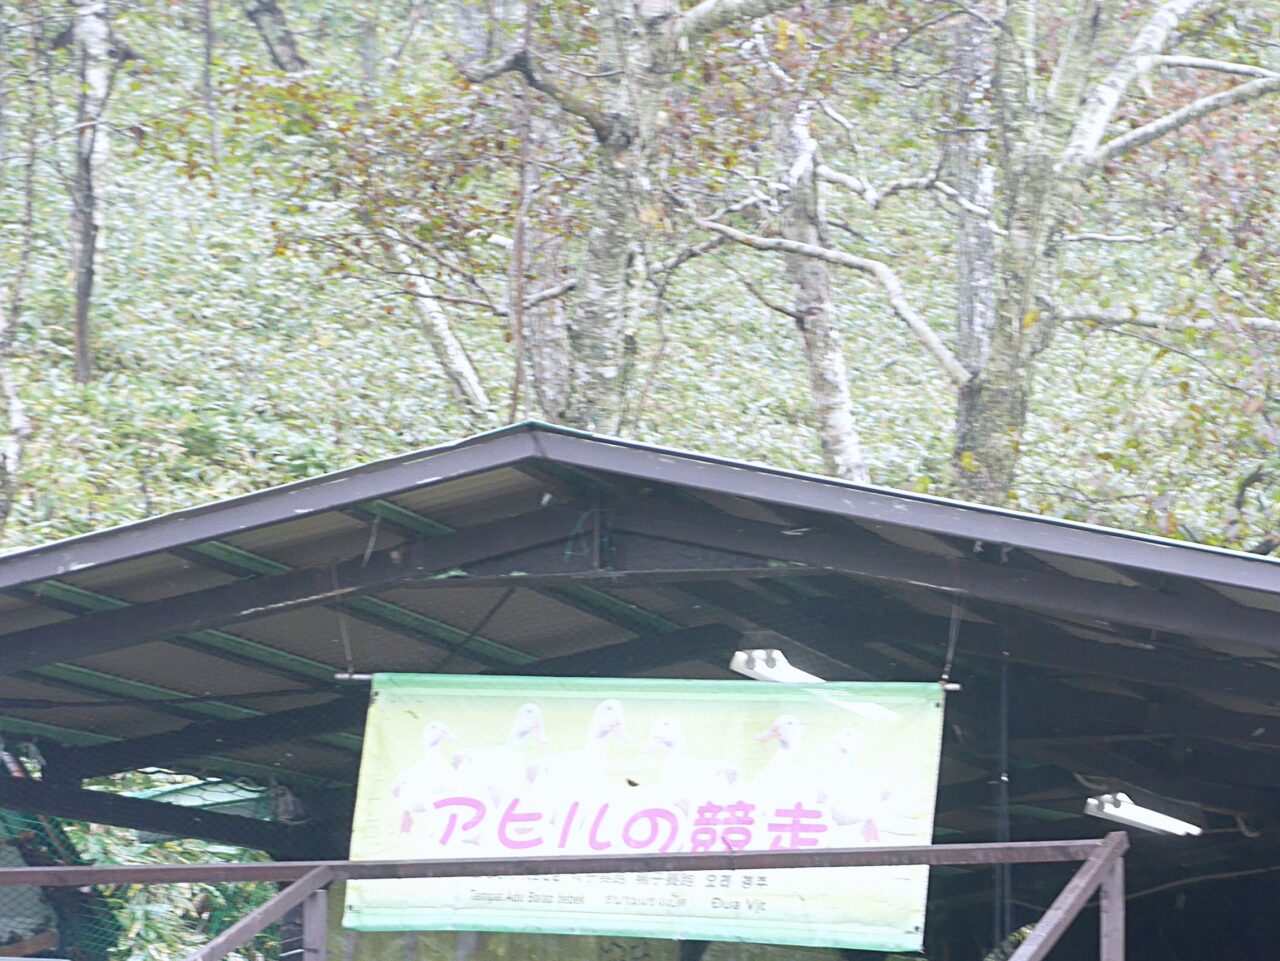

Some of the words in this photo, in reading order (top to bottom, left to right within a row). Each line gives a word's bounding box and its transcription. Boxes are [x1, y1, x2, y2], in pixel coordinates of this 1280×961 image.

[433, 797, 828, 854] アヒルの競走
